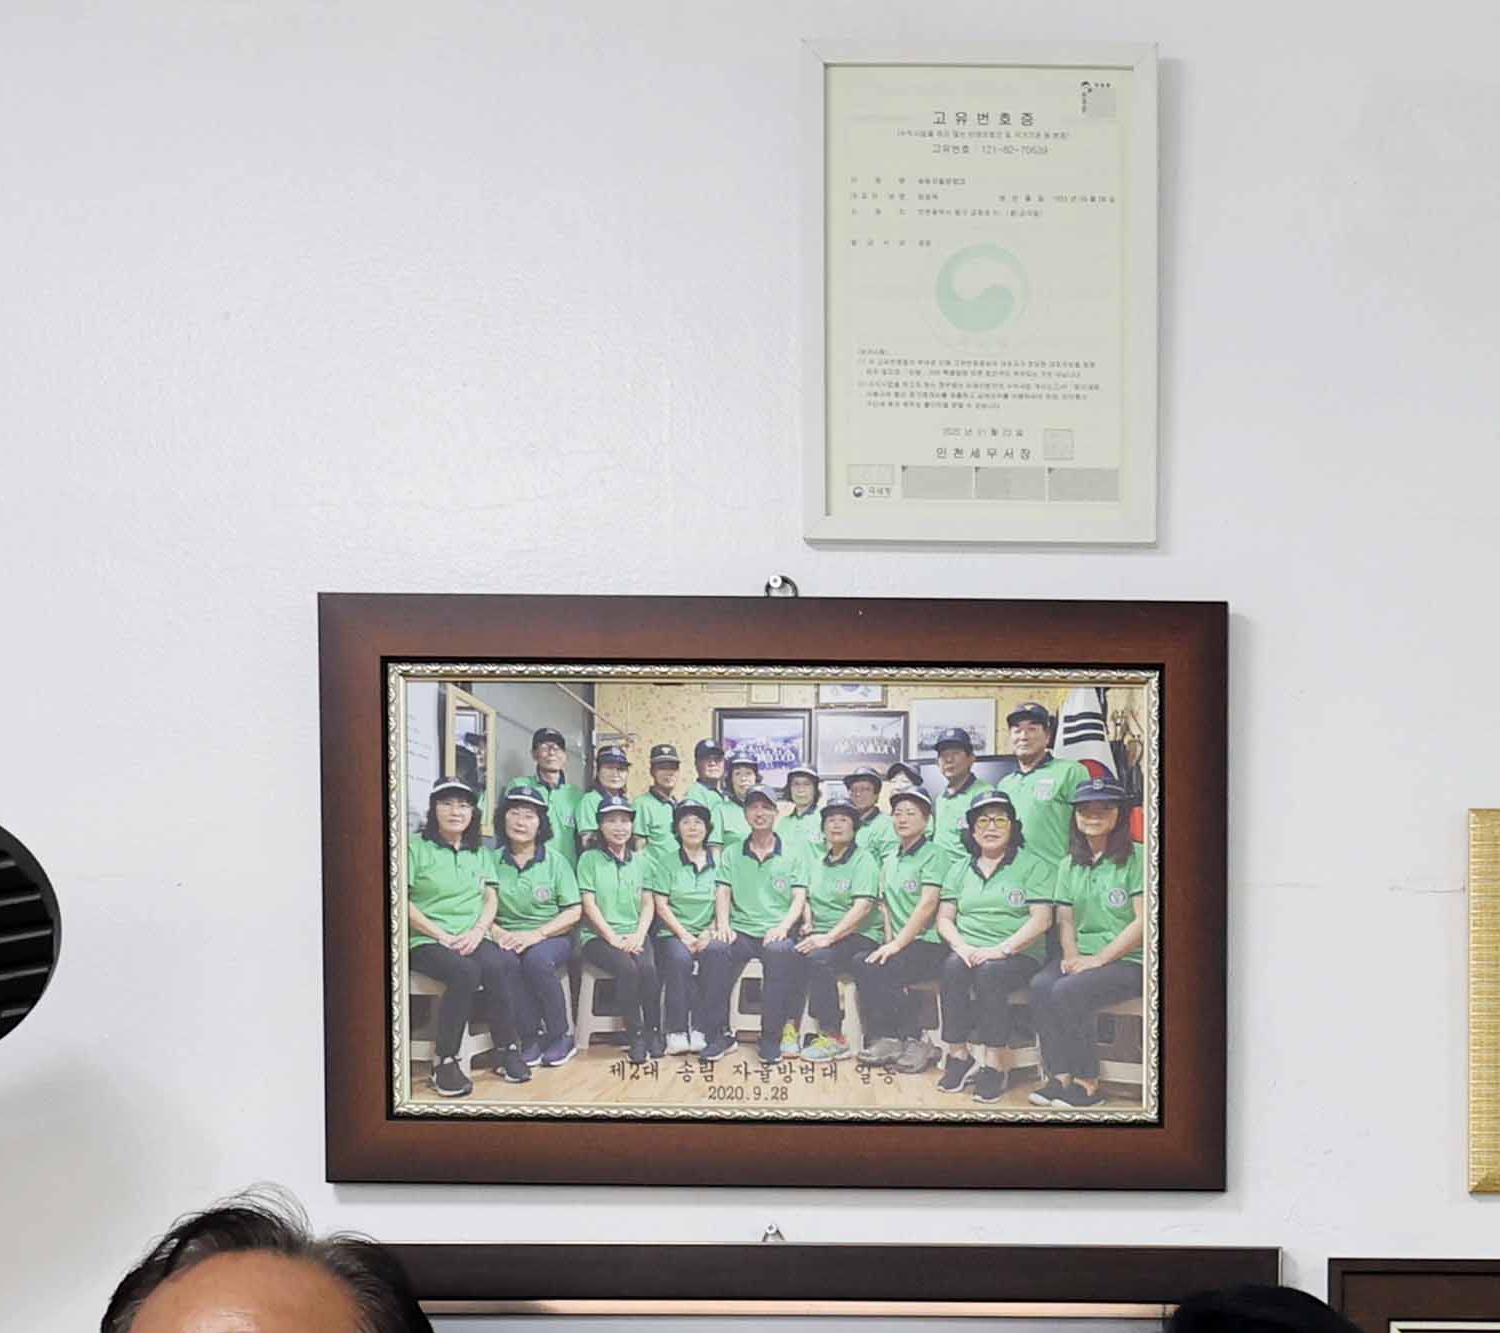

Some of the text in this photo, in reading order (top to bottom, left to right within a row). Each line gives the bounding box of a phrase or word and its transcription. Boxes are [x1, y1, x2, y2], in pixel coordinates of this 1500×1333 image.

[609, 1061, 660, 1081] 제2대
[675, 1061, 715, 1083] 송림
[732, 1061, 838, 1083] 자율방범대
[708, 1086, 789, 1101] 2020.9.28
